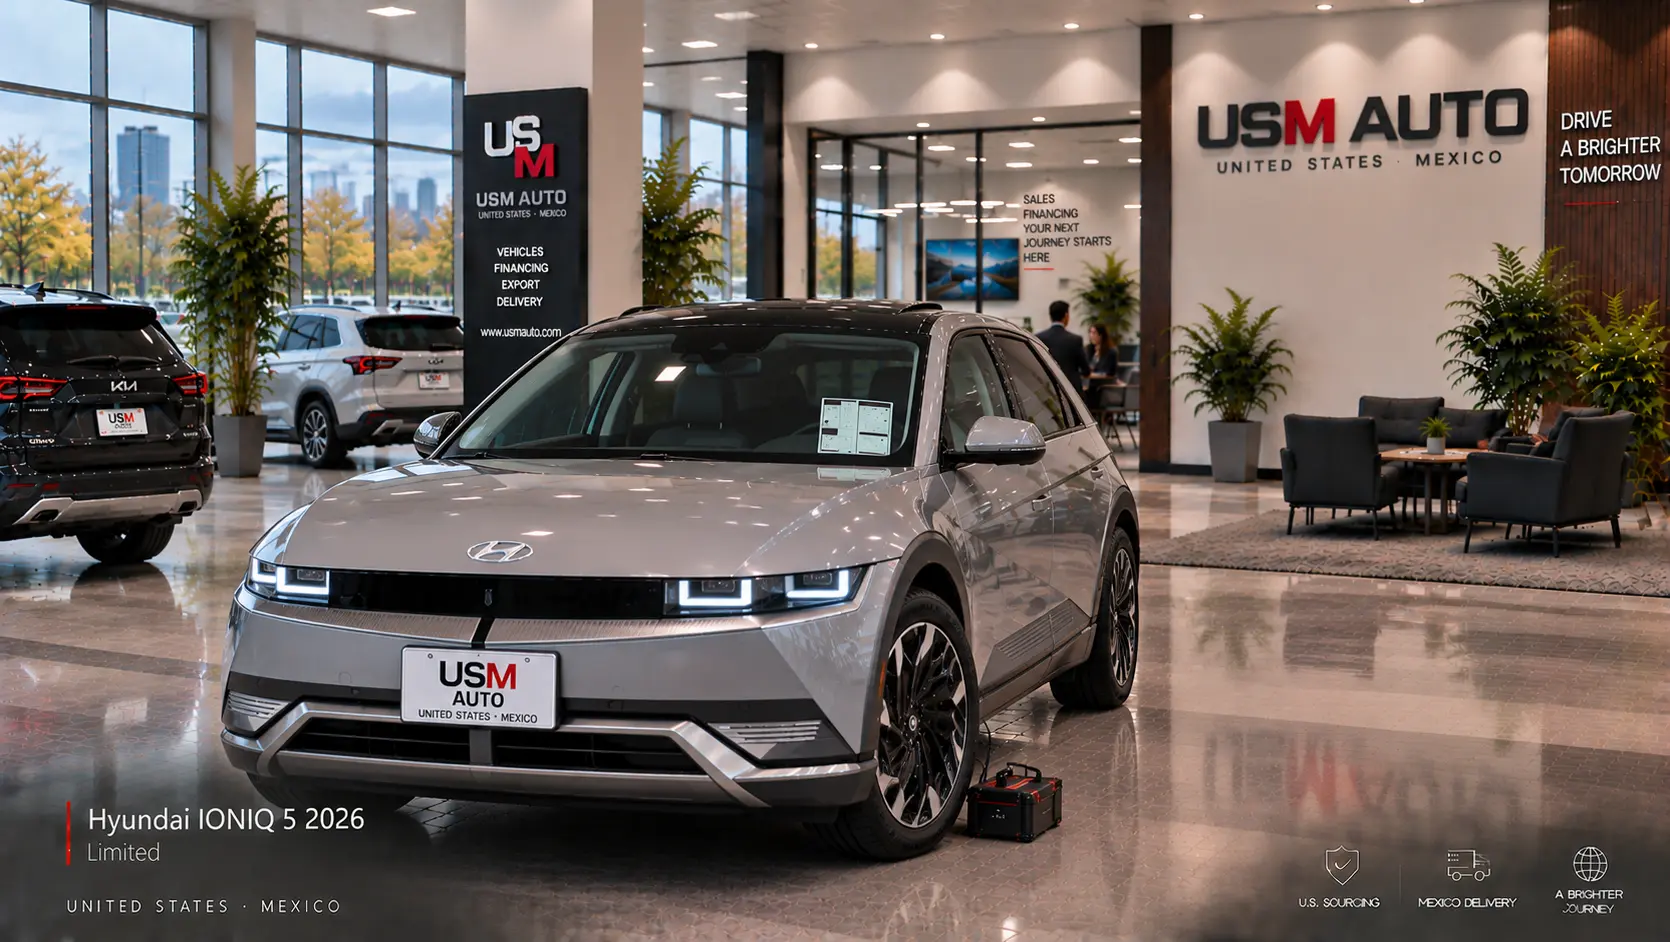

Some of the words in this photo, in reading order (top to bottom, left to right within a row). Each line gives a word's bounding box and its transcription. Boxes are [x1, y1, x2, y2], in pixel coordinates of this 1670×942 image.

[1197, 98, 1335, 149] USM
[1348, 88, 1529, 142] AUTO
[1561, 110, 1612, 130] DRIVE
[484, 115, 555, 178] USM
[1560, 140, 1573, 157] A
[1578, 136, 1661, 156] BRIGHTER
[1216, 159, 1292, 175] UNITED
[1307, 154, 1383, 171] STATES
[1415, 150, 1502, 167] MEXICO
[1560, 163, 1661, 184] TOMORROW
[476, 191, 514, 207] USM
[518, 190, 567, 206] AUTO
[1023, 194, 1055, 204] SALES
[478, 210, 504, 219] UNITED
[505, 209, 531, 218] STATES
[539, 208, 567, 218] MEXICO
[1023, 208, 1079, 219] FINANCING
[1023, 223, 1052, 233] YOUR
[1054, 222, 1080, 232] NEXT
[1023, 237, 1070, 248] JOURNEY
[1073, 236, 1112, 246] STARTS
[496, 246, 544, 257] VEHICLES
[1023, 252, 1050, 263] HERE
[494, 263, 549, 273] FINANCING
[501, 279, 541, 290] EXPORT
[496, 296, 543, 307] DELIVERY
[480, 326, 562, 337] www.usmauto.com
[108, 412, 135, 424] USM
[439, 660, 517, 689] USM
[452, 691, 504, 708] AUTO
[418, 709, 453, 719] UNITED
[455, 711, 491, 721] STATES
[500, 713, 538, 723] MEXICO
